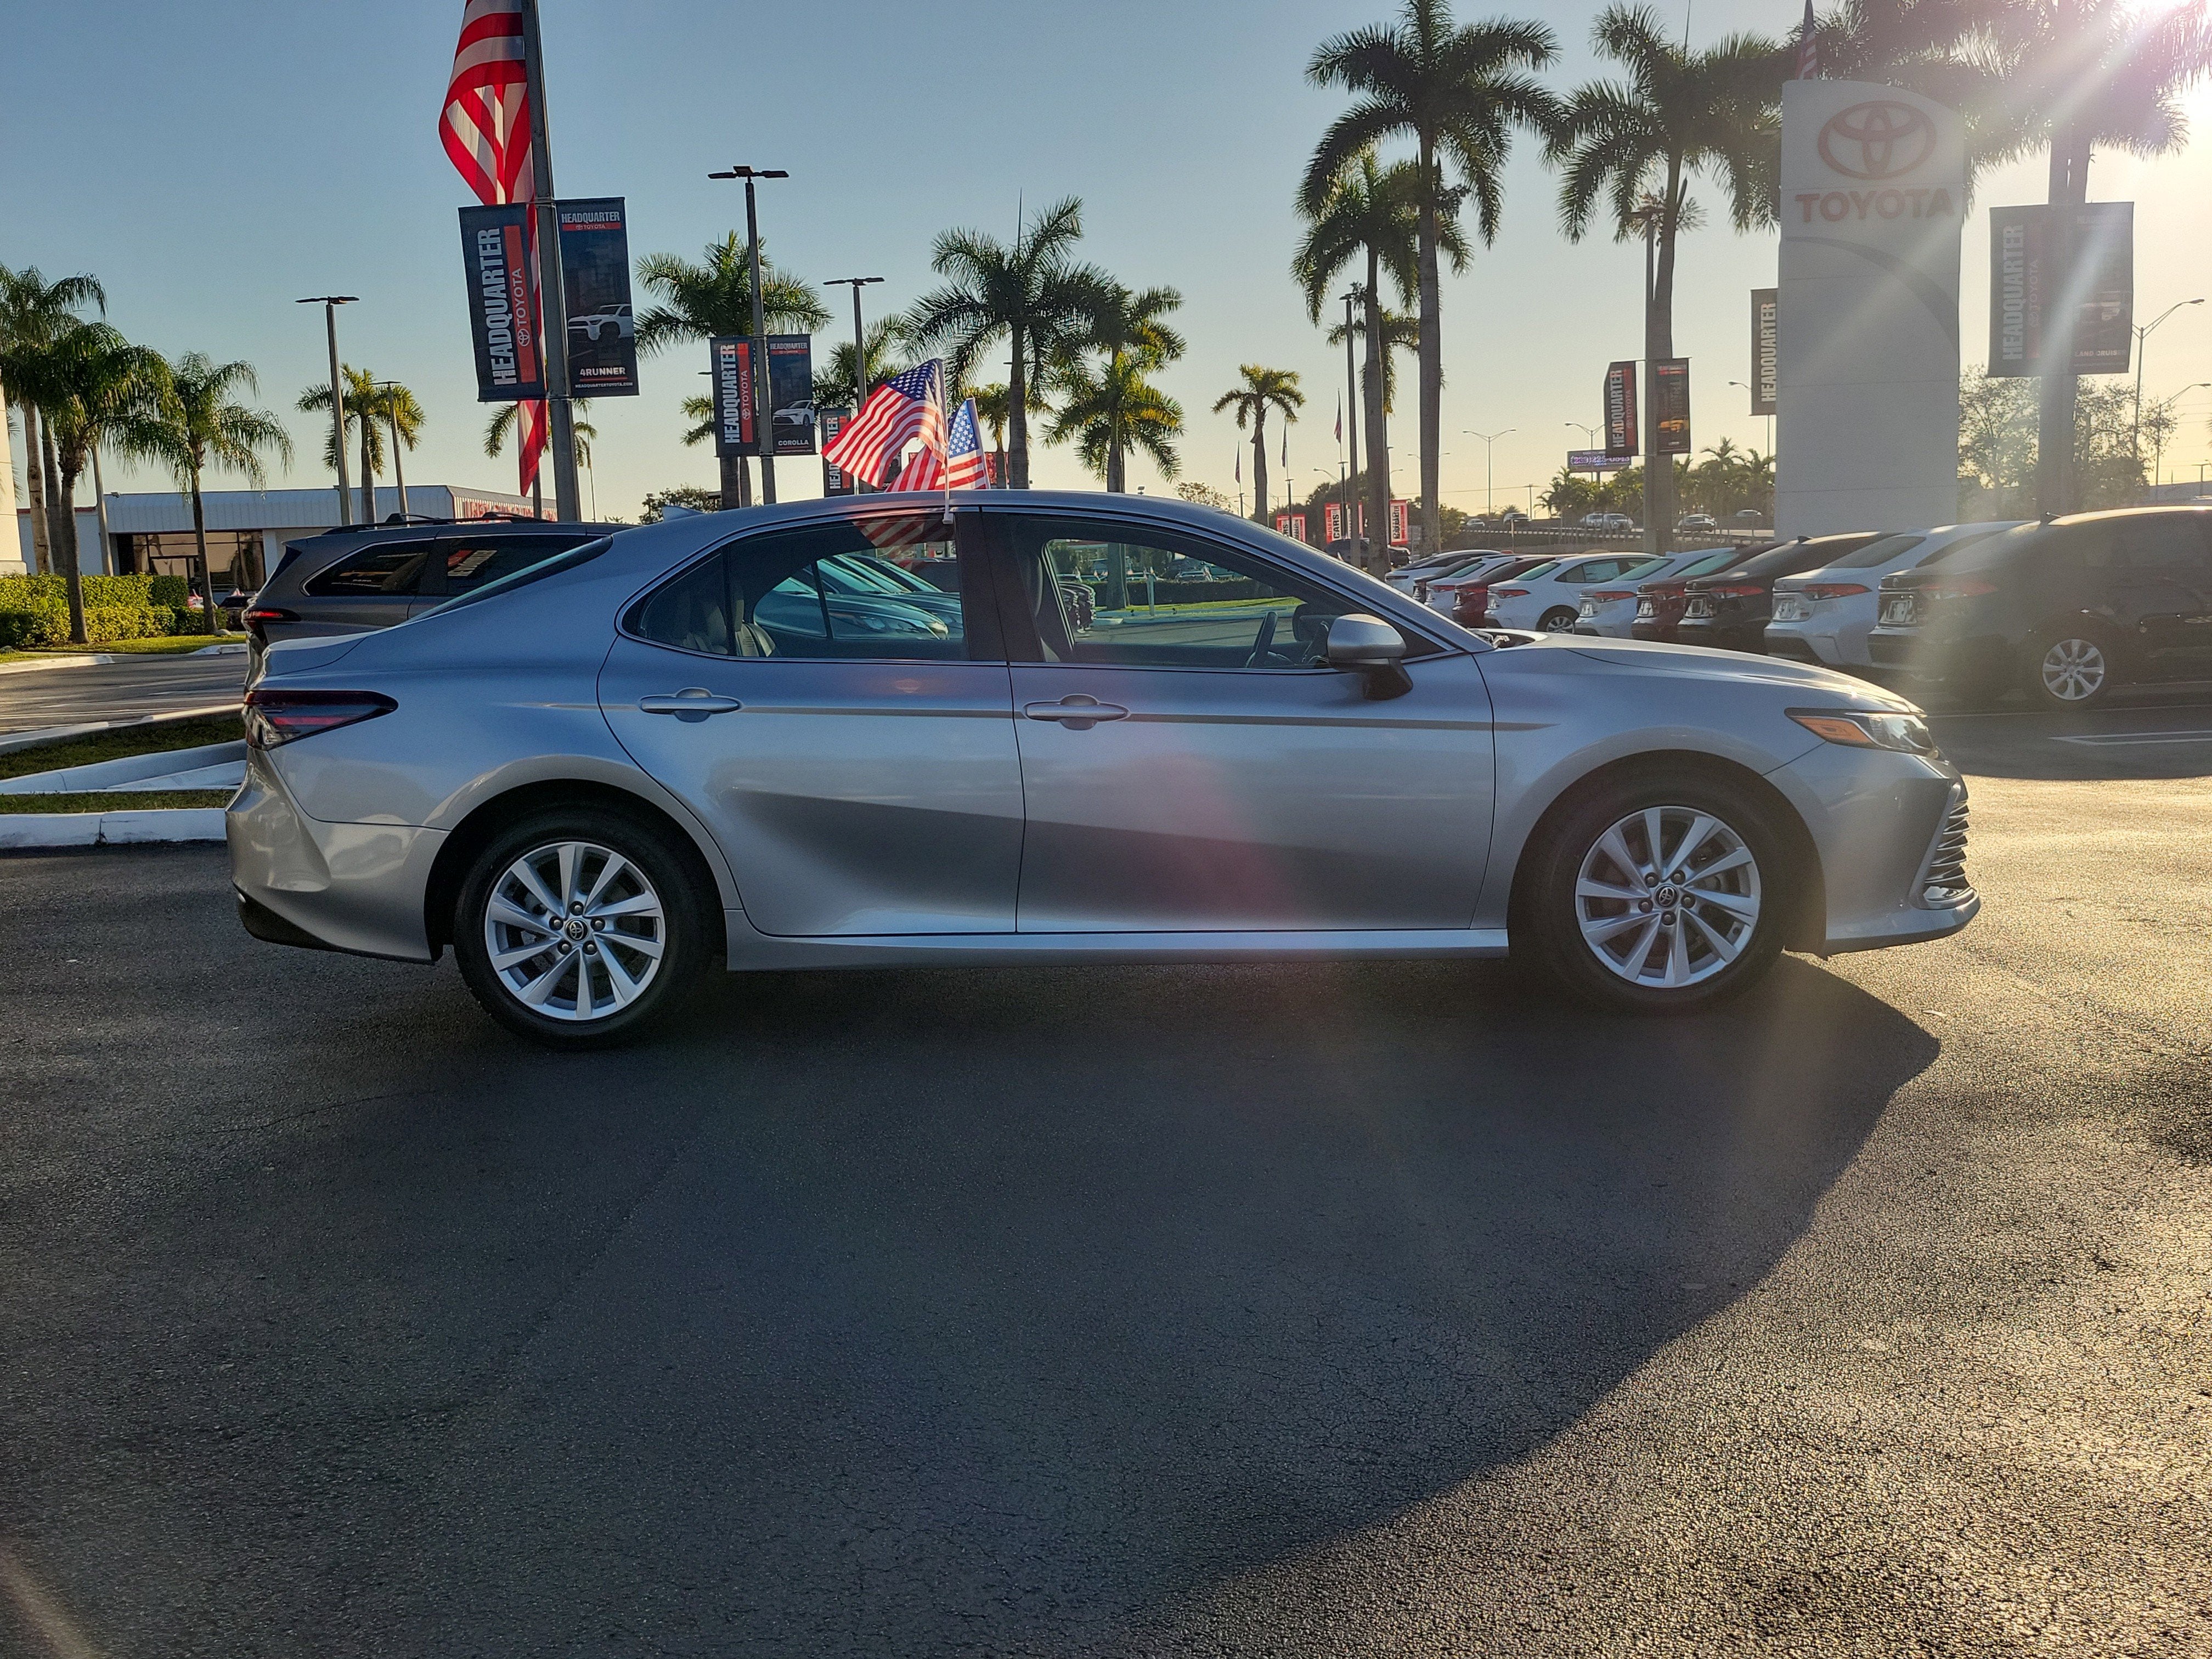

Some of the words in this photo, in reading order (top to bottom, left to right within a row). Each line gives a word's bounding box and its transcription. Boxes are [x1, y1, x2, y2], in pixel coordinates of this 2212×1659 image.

[561, 211, 620, 224] HEADQUARTER
[1795, 188, 1955, 223] TOYOTA
[477, 228, 517, 385] HEADQUARTER
[511, 268, 527, 327] TOYOTA
[2002, 224, 2025, 360] HEADQUARTER
[2030, 259, 2039, 309] TOYOTA
[580, 367, 626, 376] 4RUNNER
[720, 344, 740, 443] HEADQUARTER
[741, 370, 749, 407] TOYOTA
[1610, 370, 1625, 448] HEADQUARTER
